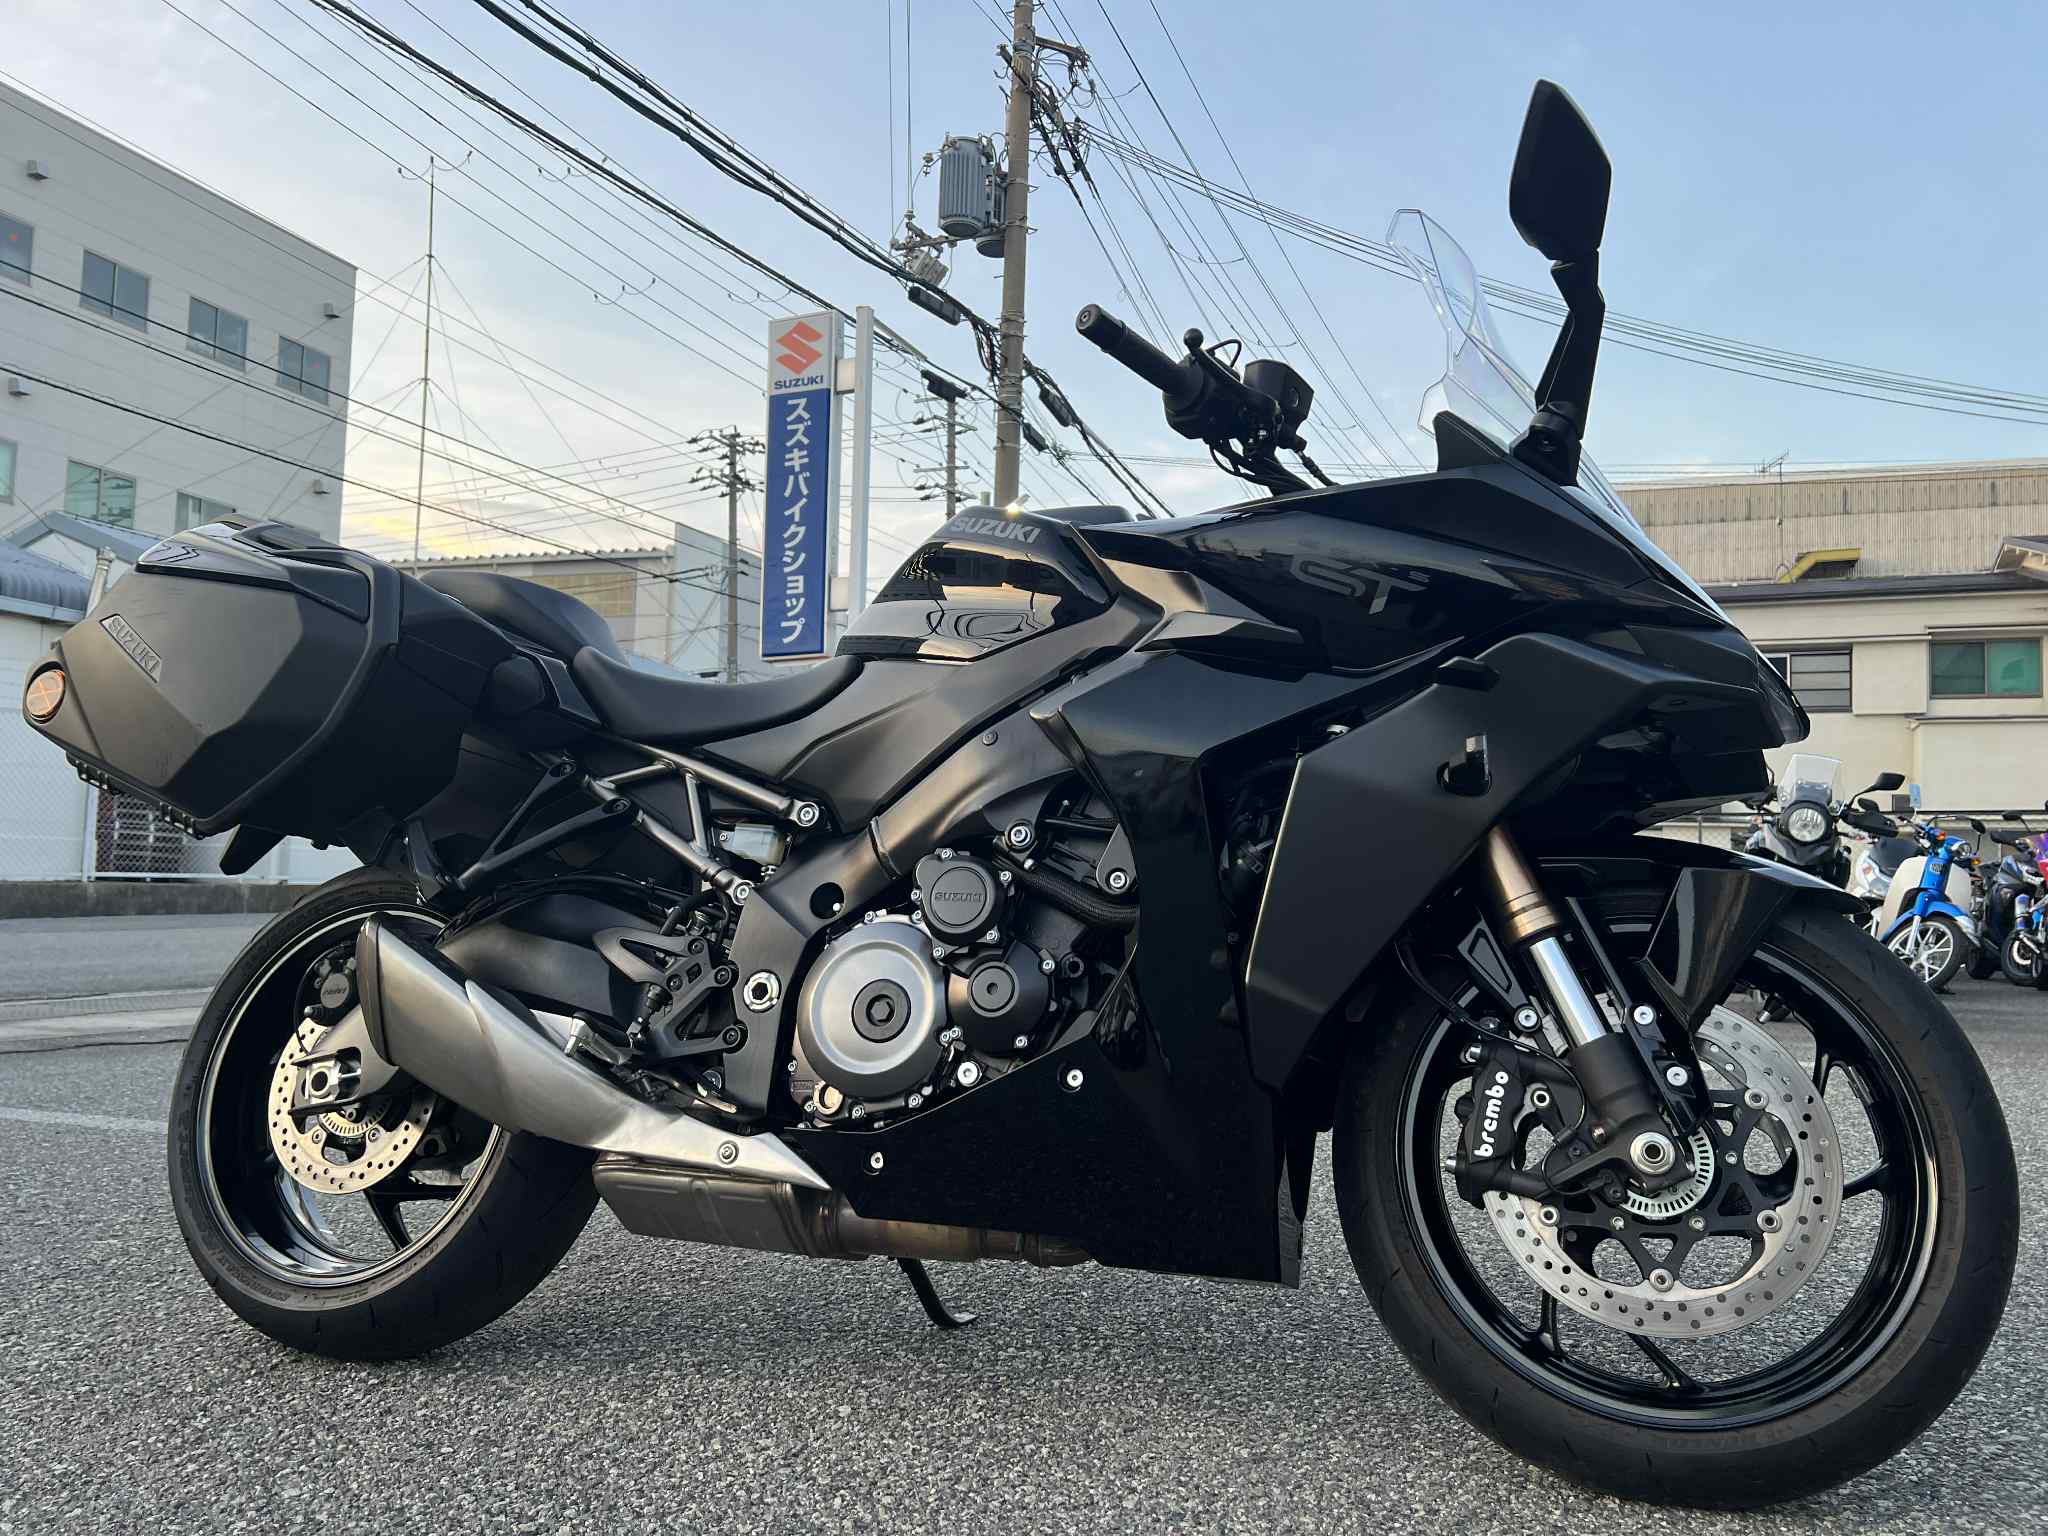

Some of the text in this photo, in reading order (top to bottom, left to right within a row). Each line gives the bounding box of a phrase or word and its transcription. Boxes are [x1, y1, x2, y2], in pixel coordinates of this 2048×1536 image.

[774, 375, 824, 389] SUZUKI
[781, 397, 811, 644] スズキバイクショップ
[951, 517, 1041, 544] SUZUKI
[108, 617, 161, 674] SUZUKI
[1474, 1071, 1509, 1157] brembo
